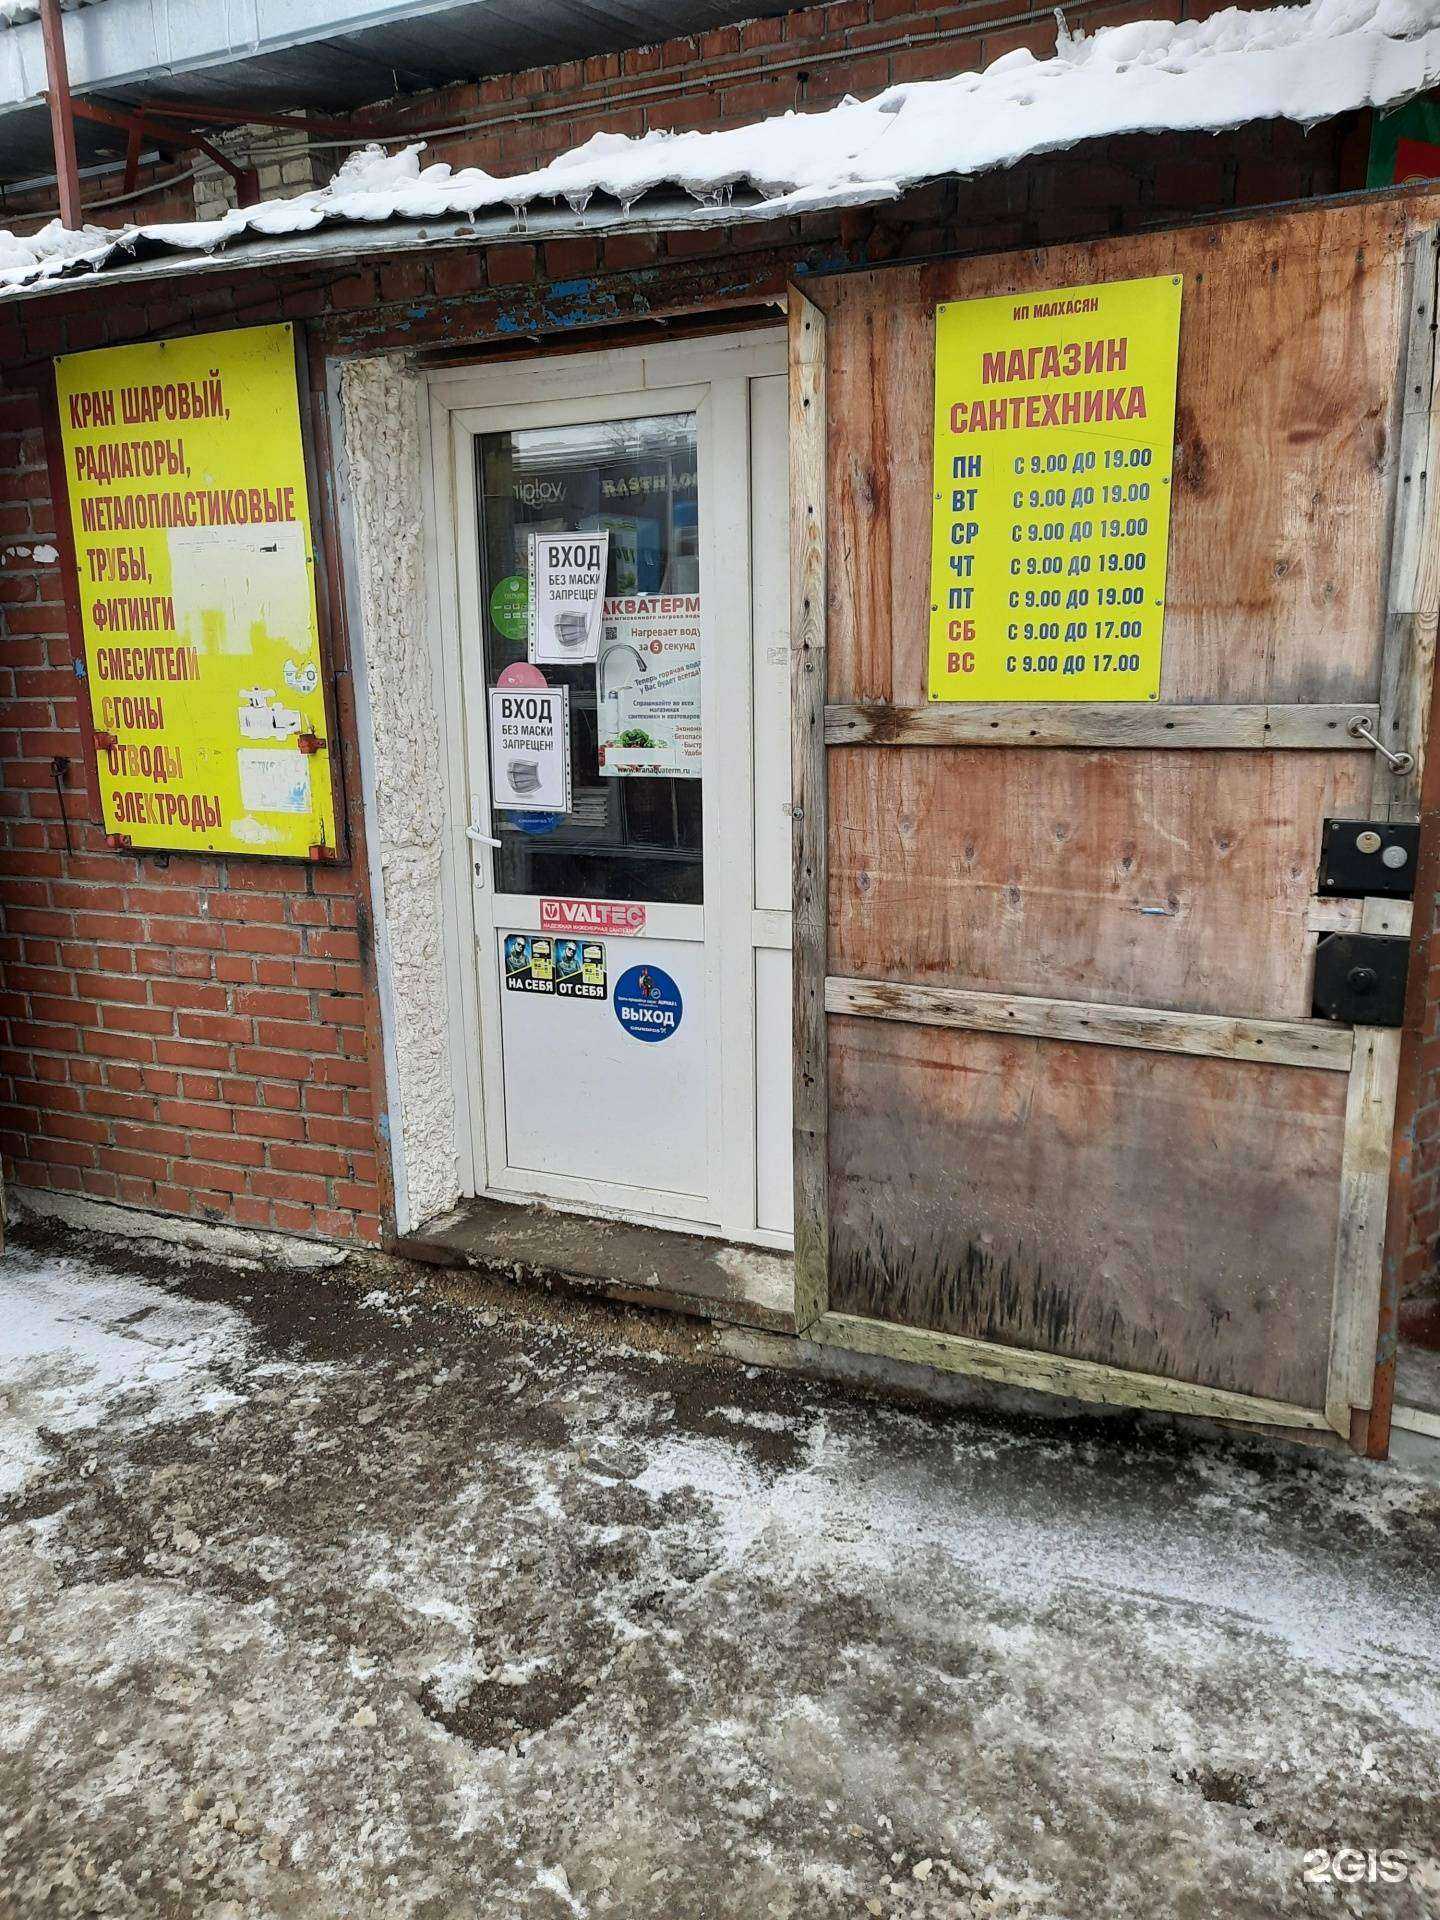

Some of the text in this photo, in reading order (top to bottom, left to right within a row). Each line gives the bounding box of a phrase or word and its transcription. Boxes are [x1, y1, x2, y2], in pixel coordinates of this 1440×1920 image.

[1013, 297, 1098, 321] ИП МАЛХАСЯН
[982, 337, 1128, 385] МАГАЗИН
[69, 368, 230, 430] КРАН ШАРОВЫЙ,
[950, 386, 1147, 434] САНТЕХНИКА
[74, 438, 191, 486] РАДИАТОРЫ,
[953, 448, 1152, 479] ПН С 9.00 ДО 19.00
[80, 486, 296, 532] МЕТАЛОПЛАСТИКОВЫЕ
[952, 483, 1150, 512] ВТ С 9.00 ДО 19.00
[951, 517, 1148, 545] СР С 9.00 ДО 19.00
[86, 546, 153, 584] ТРУБЫ,
[548, 545, 601, 571] ВХОД
[949, 552, 1146, 577] ЧТ С 9.00 ДО 19.00
[549, 574, 566, 586] БЕЗ
[949, 587, 1144, 609] ПТ С 9.00 ДО 19.00
[92, 596, 176, 631] ФИТИНГИ
[631, 627, 677, 639] Нагревает
[948, 620, 1142, 642] СБ С 9.00 ДО 17.00
[639, 643, 648, 651] за
[664, 643, 696, 653] секунд
[97, 647, 201, 681] СМЕСИТЕЛИ
[947, 652, 1140, 674] ВС С 9.00 ДО 17.00
[634, 674, 657, 686] Теперь
[658, 666, 685, 679] горячая
[644, 684, 657, 692] Вас
[657, 677, 676, 688] будет
[102, 697, 164, 729] СГОНЫ
[502, 698, 552, 723] ВХОД
[502, 724, 553, 737] БЕЗ МАСКИ
[502, 739, 554, 752] ЗАПРЕЩЕН!
[107, 744, 183, 783] ОТВОДЫ
[617, 767, 691, 775] www.kranaquaterm.ru
[112, 791, 223, 833] ЭЛЕКТРОДЫ
[561, 902, 643, 927] VALTEC
[508, 978, 553, 992] НА СЕБЯ
[560, 983, 604, 997] ОТ СЕБЯ
[621, 1006, 675, 1028] ВЫХОД
